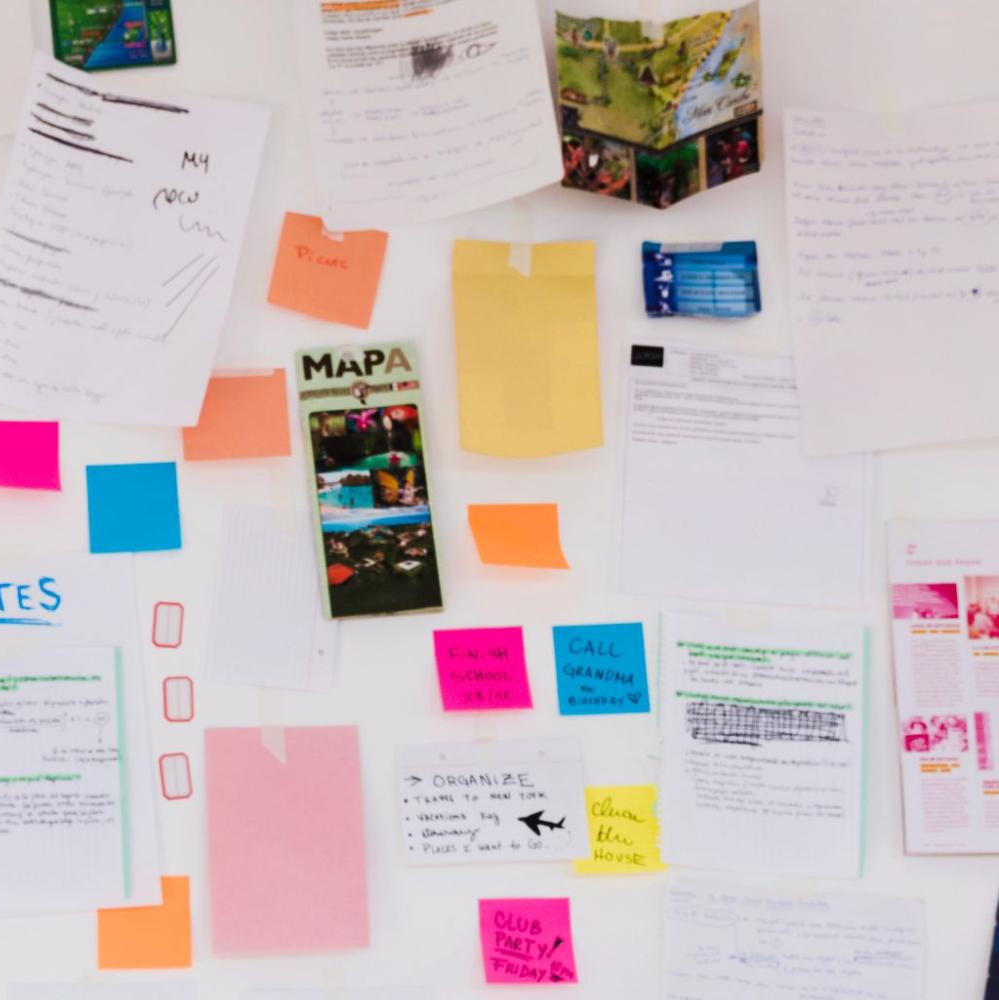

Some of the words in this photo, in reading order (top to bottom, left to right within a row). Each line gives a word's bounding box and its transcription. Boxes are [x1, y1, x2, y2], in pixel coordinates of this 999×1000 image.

[302, 347, 412, 381] MAPA
[569, 638, 622, 658] CALL
[562, 663, 635, 687] GRANDMA
[432, 773, 535, 788] ORGANIZE
[593, 850, 647, 866] HOUSE
[494, 910, 542, 935] CLUB
[490, 956, 546, 982] FRIDAY
